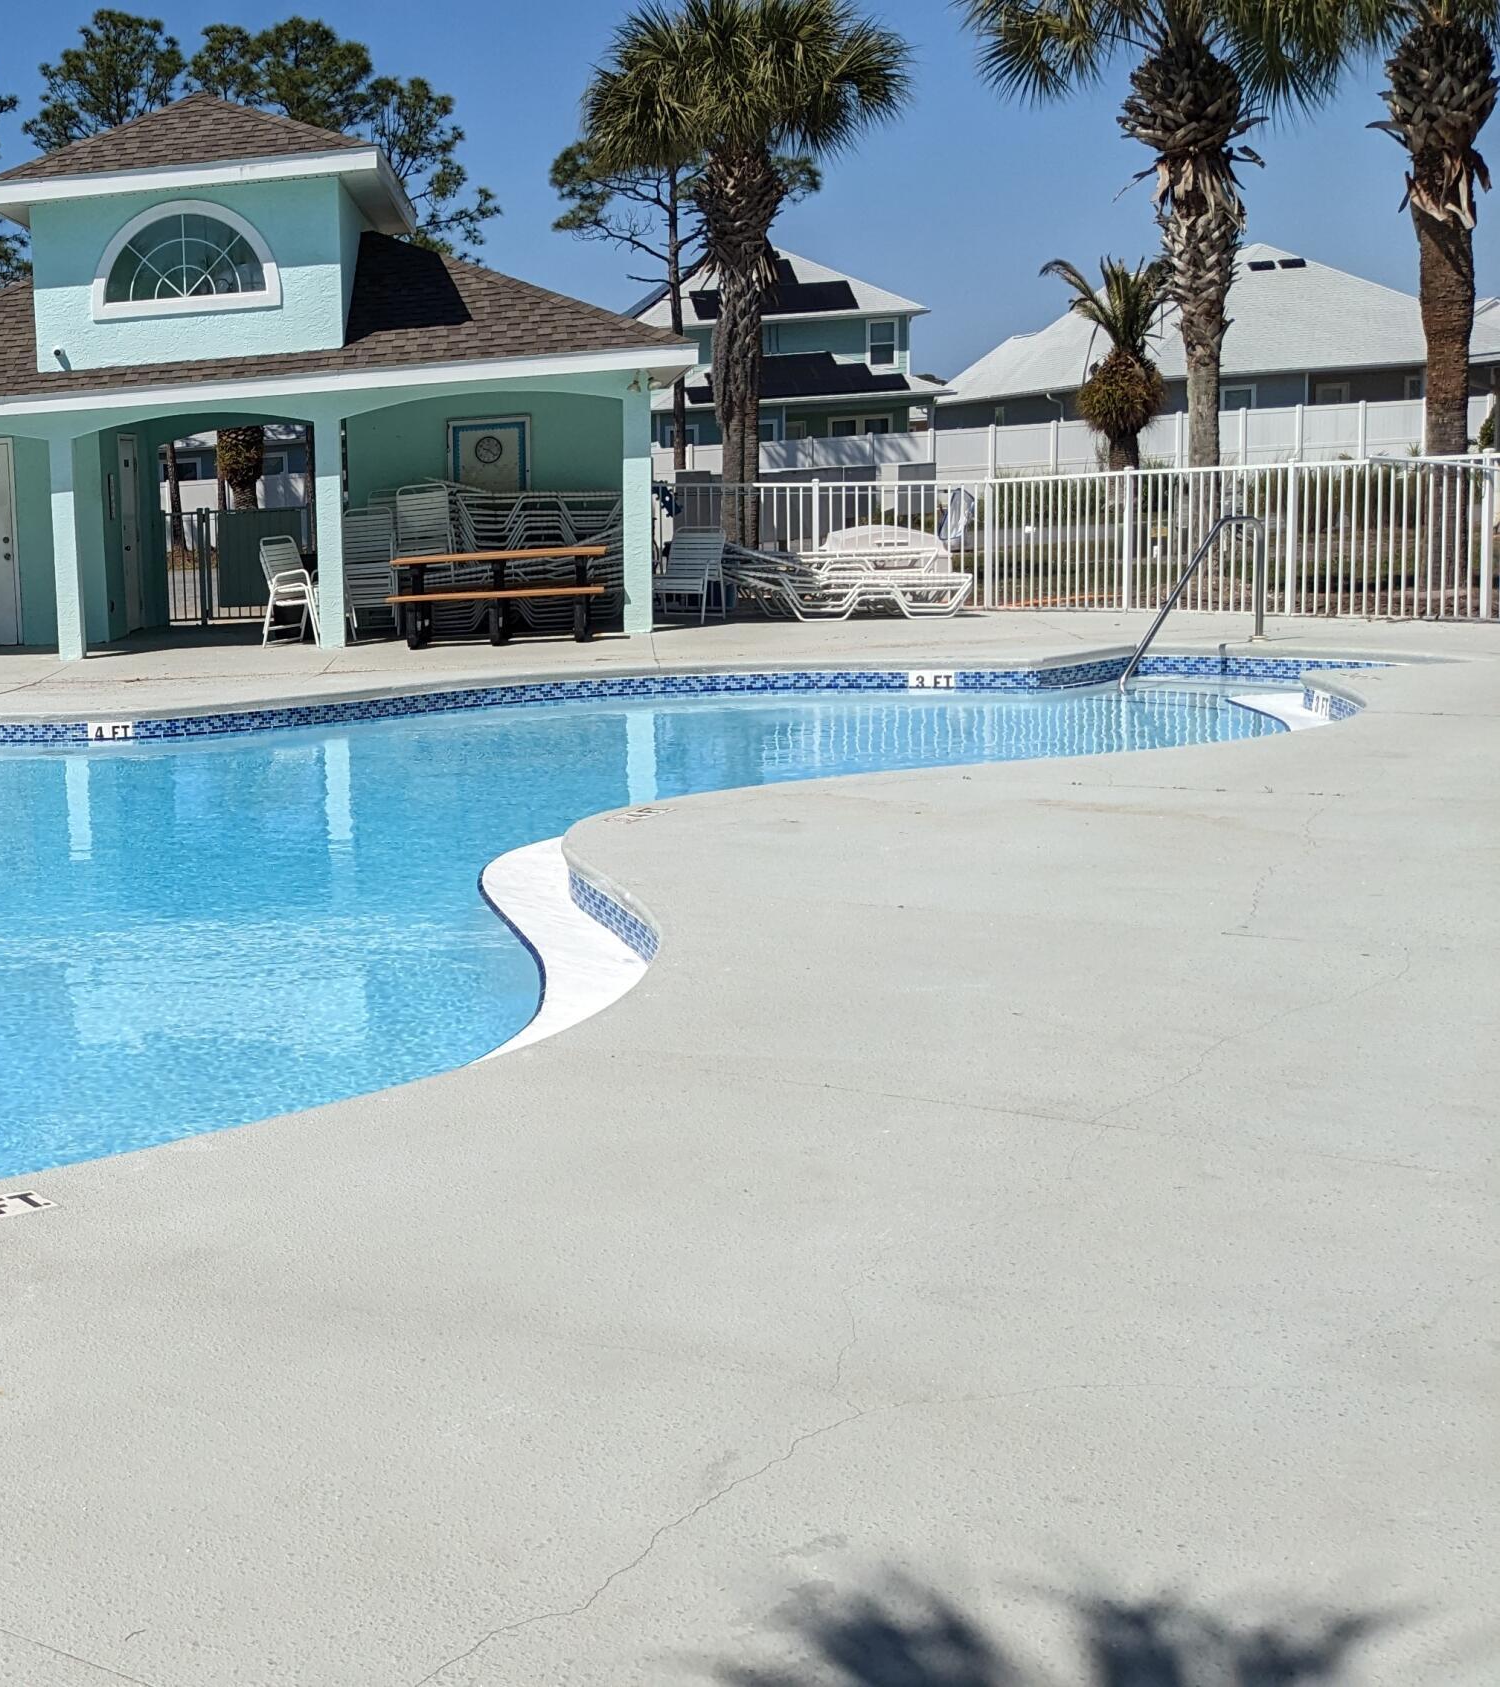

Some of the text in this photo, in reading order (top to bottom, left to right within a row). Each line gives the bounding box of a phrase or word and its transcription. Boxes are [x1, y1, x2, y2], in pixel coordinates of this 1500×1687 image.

[915, 674, 952, 689] 3 FT
[1321, 696, 1329, 716] FT
[94, 724, 130, 740] 4 FT
